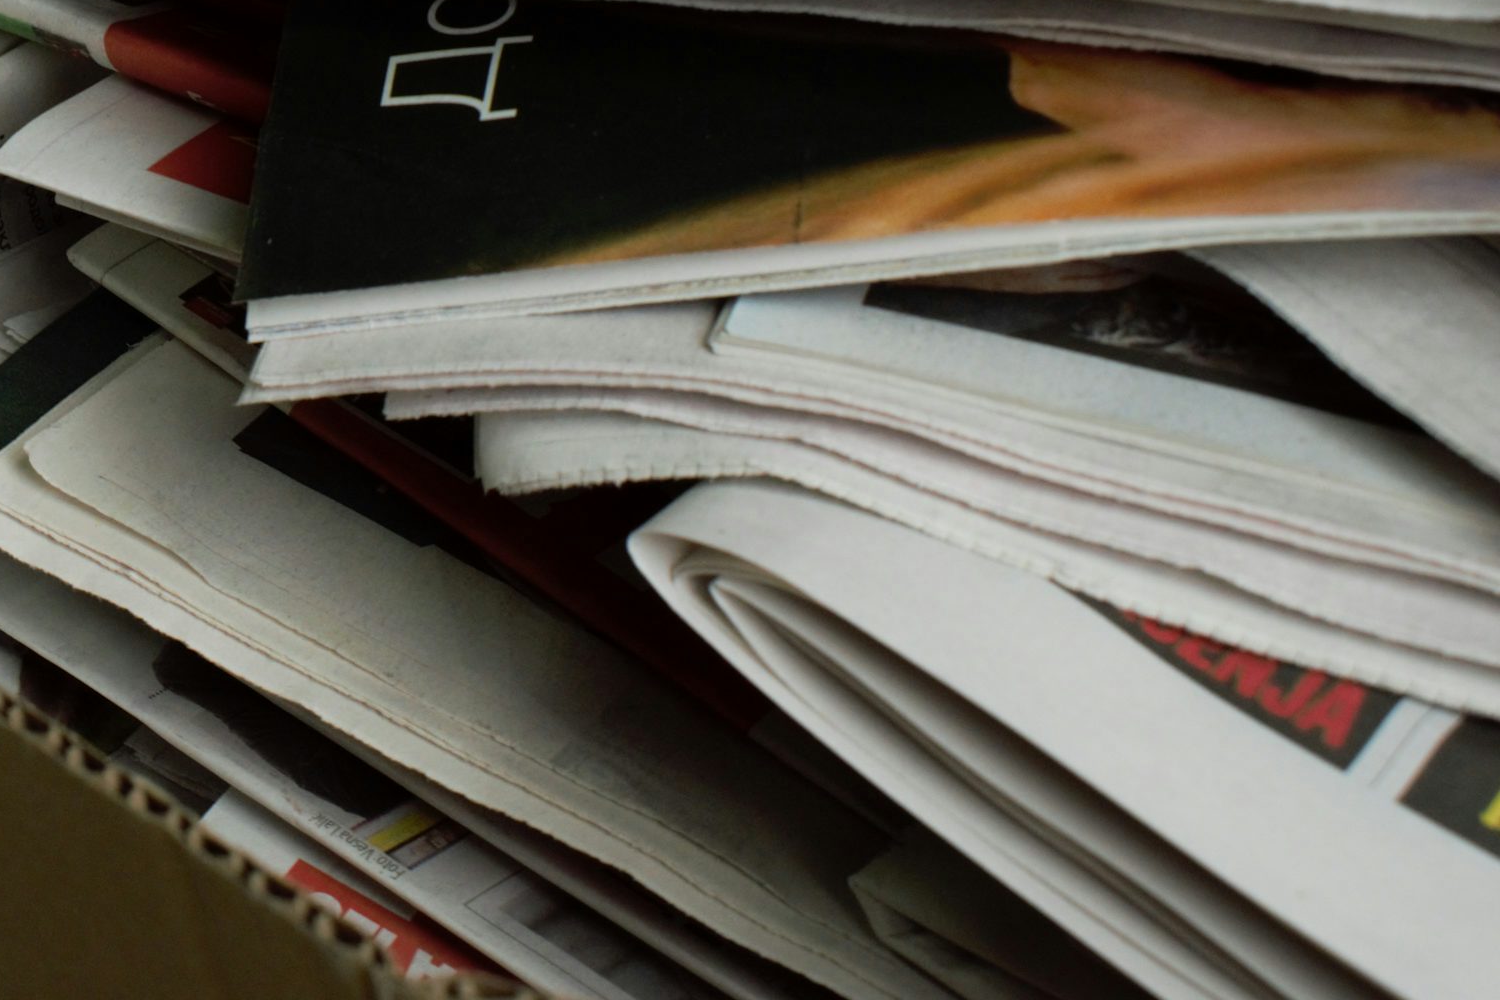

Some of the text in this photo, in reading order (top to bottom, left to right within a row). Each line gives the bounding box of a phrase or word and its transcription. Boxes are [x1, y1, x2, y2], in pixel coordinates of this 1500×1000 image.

[306, 810, 406, 882] Foto: Vesna Lalić
